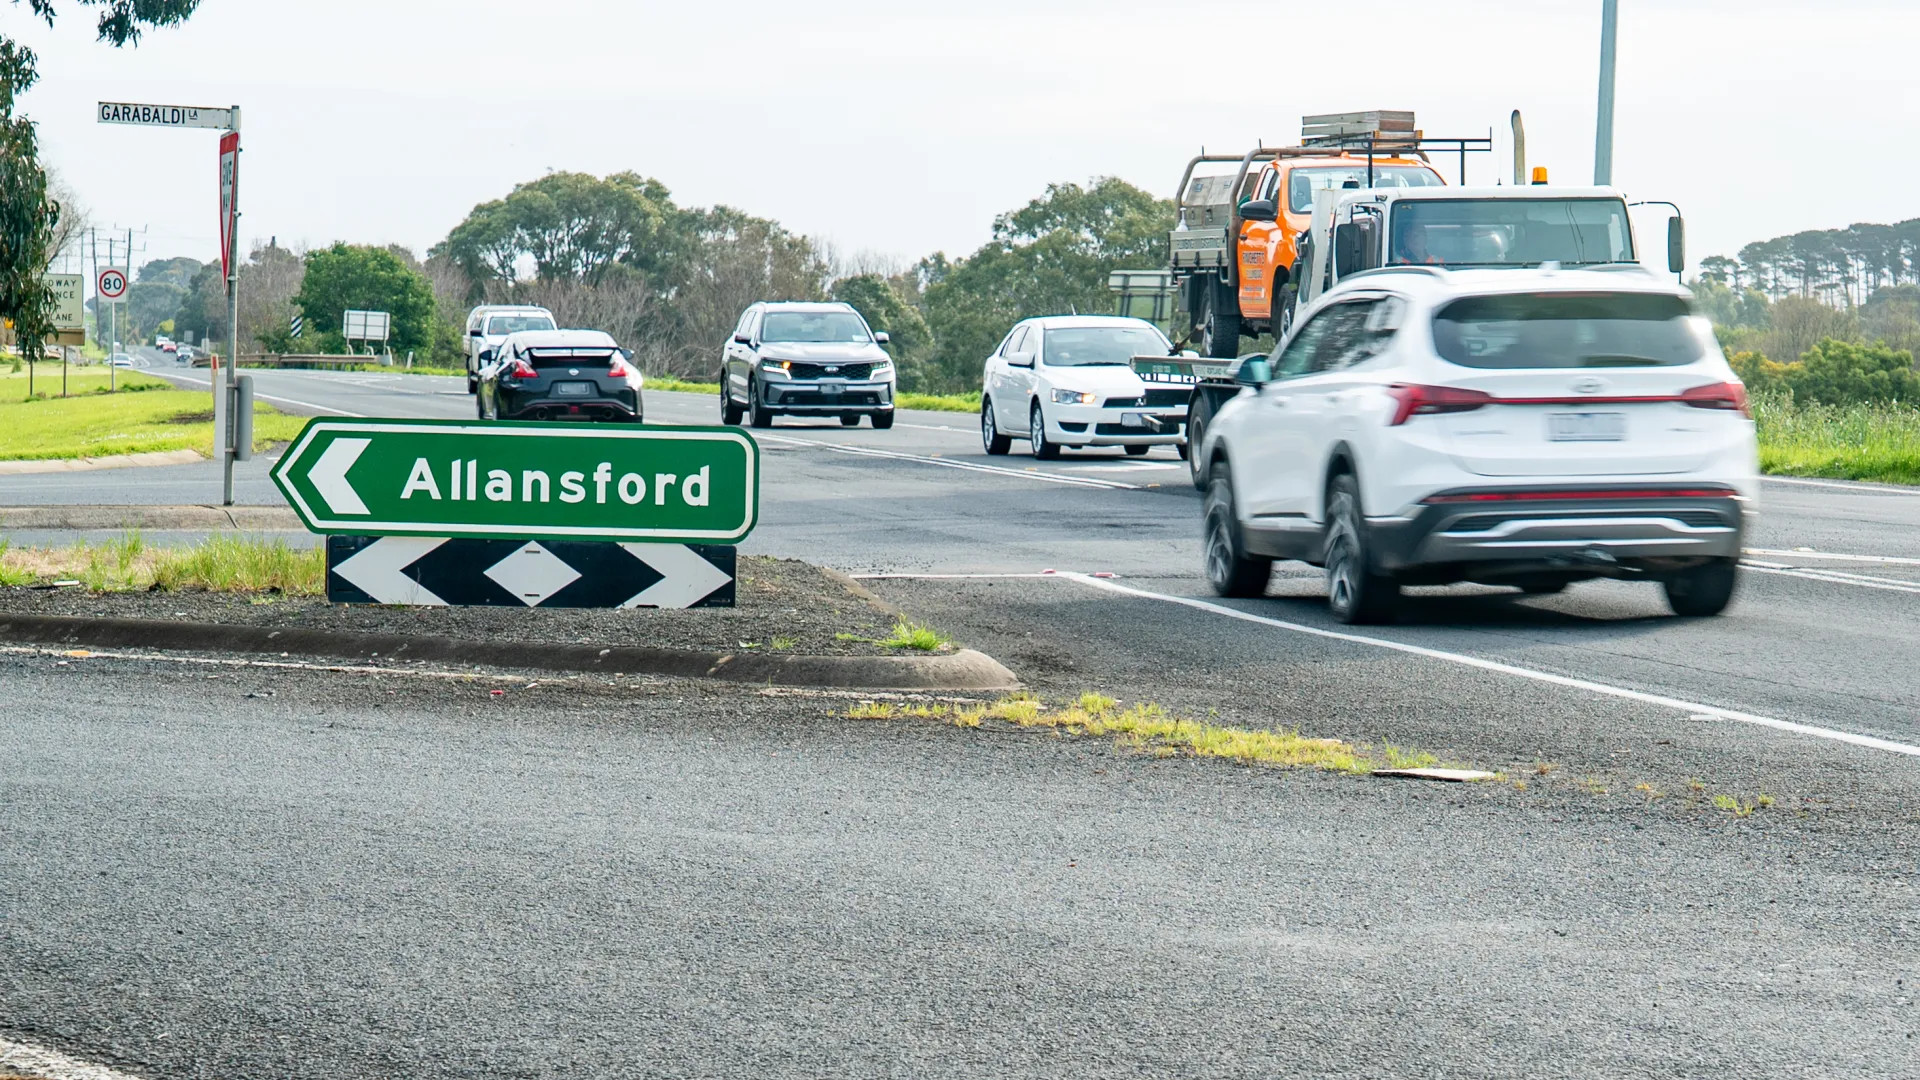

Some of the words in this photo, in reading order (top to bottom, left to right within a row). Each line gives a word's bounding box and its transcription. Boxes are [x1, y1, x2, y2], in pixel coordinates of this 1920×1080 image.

[101, 104, 185, 124] GARABALDI
[188, 109, 198, 118] LA
[103, 277, 122, 290] 80
[400, 457, 710, 507] Allansford
